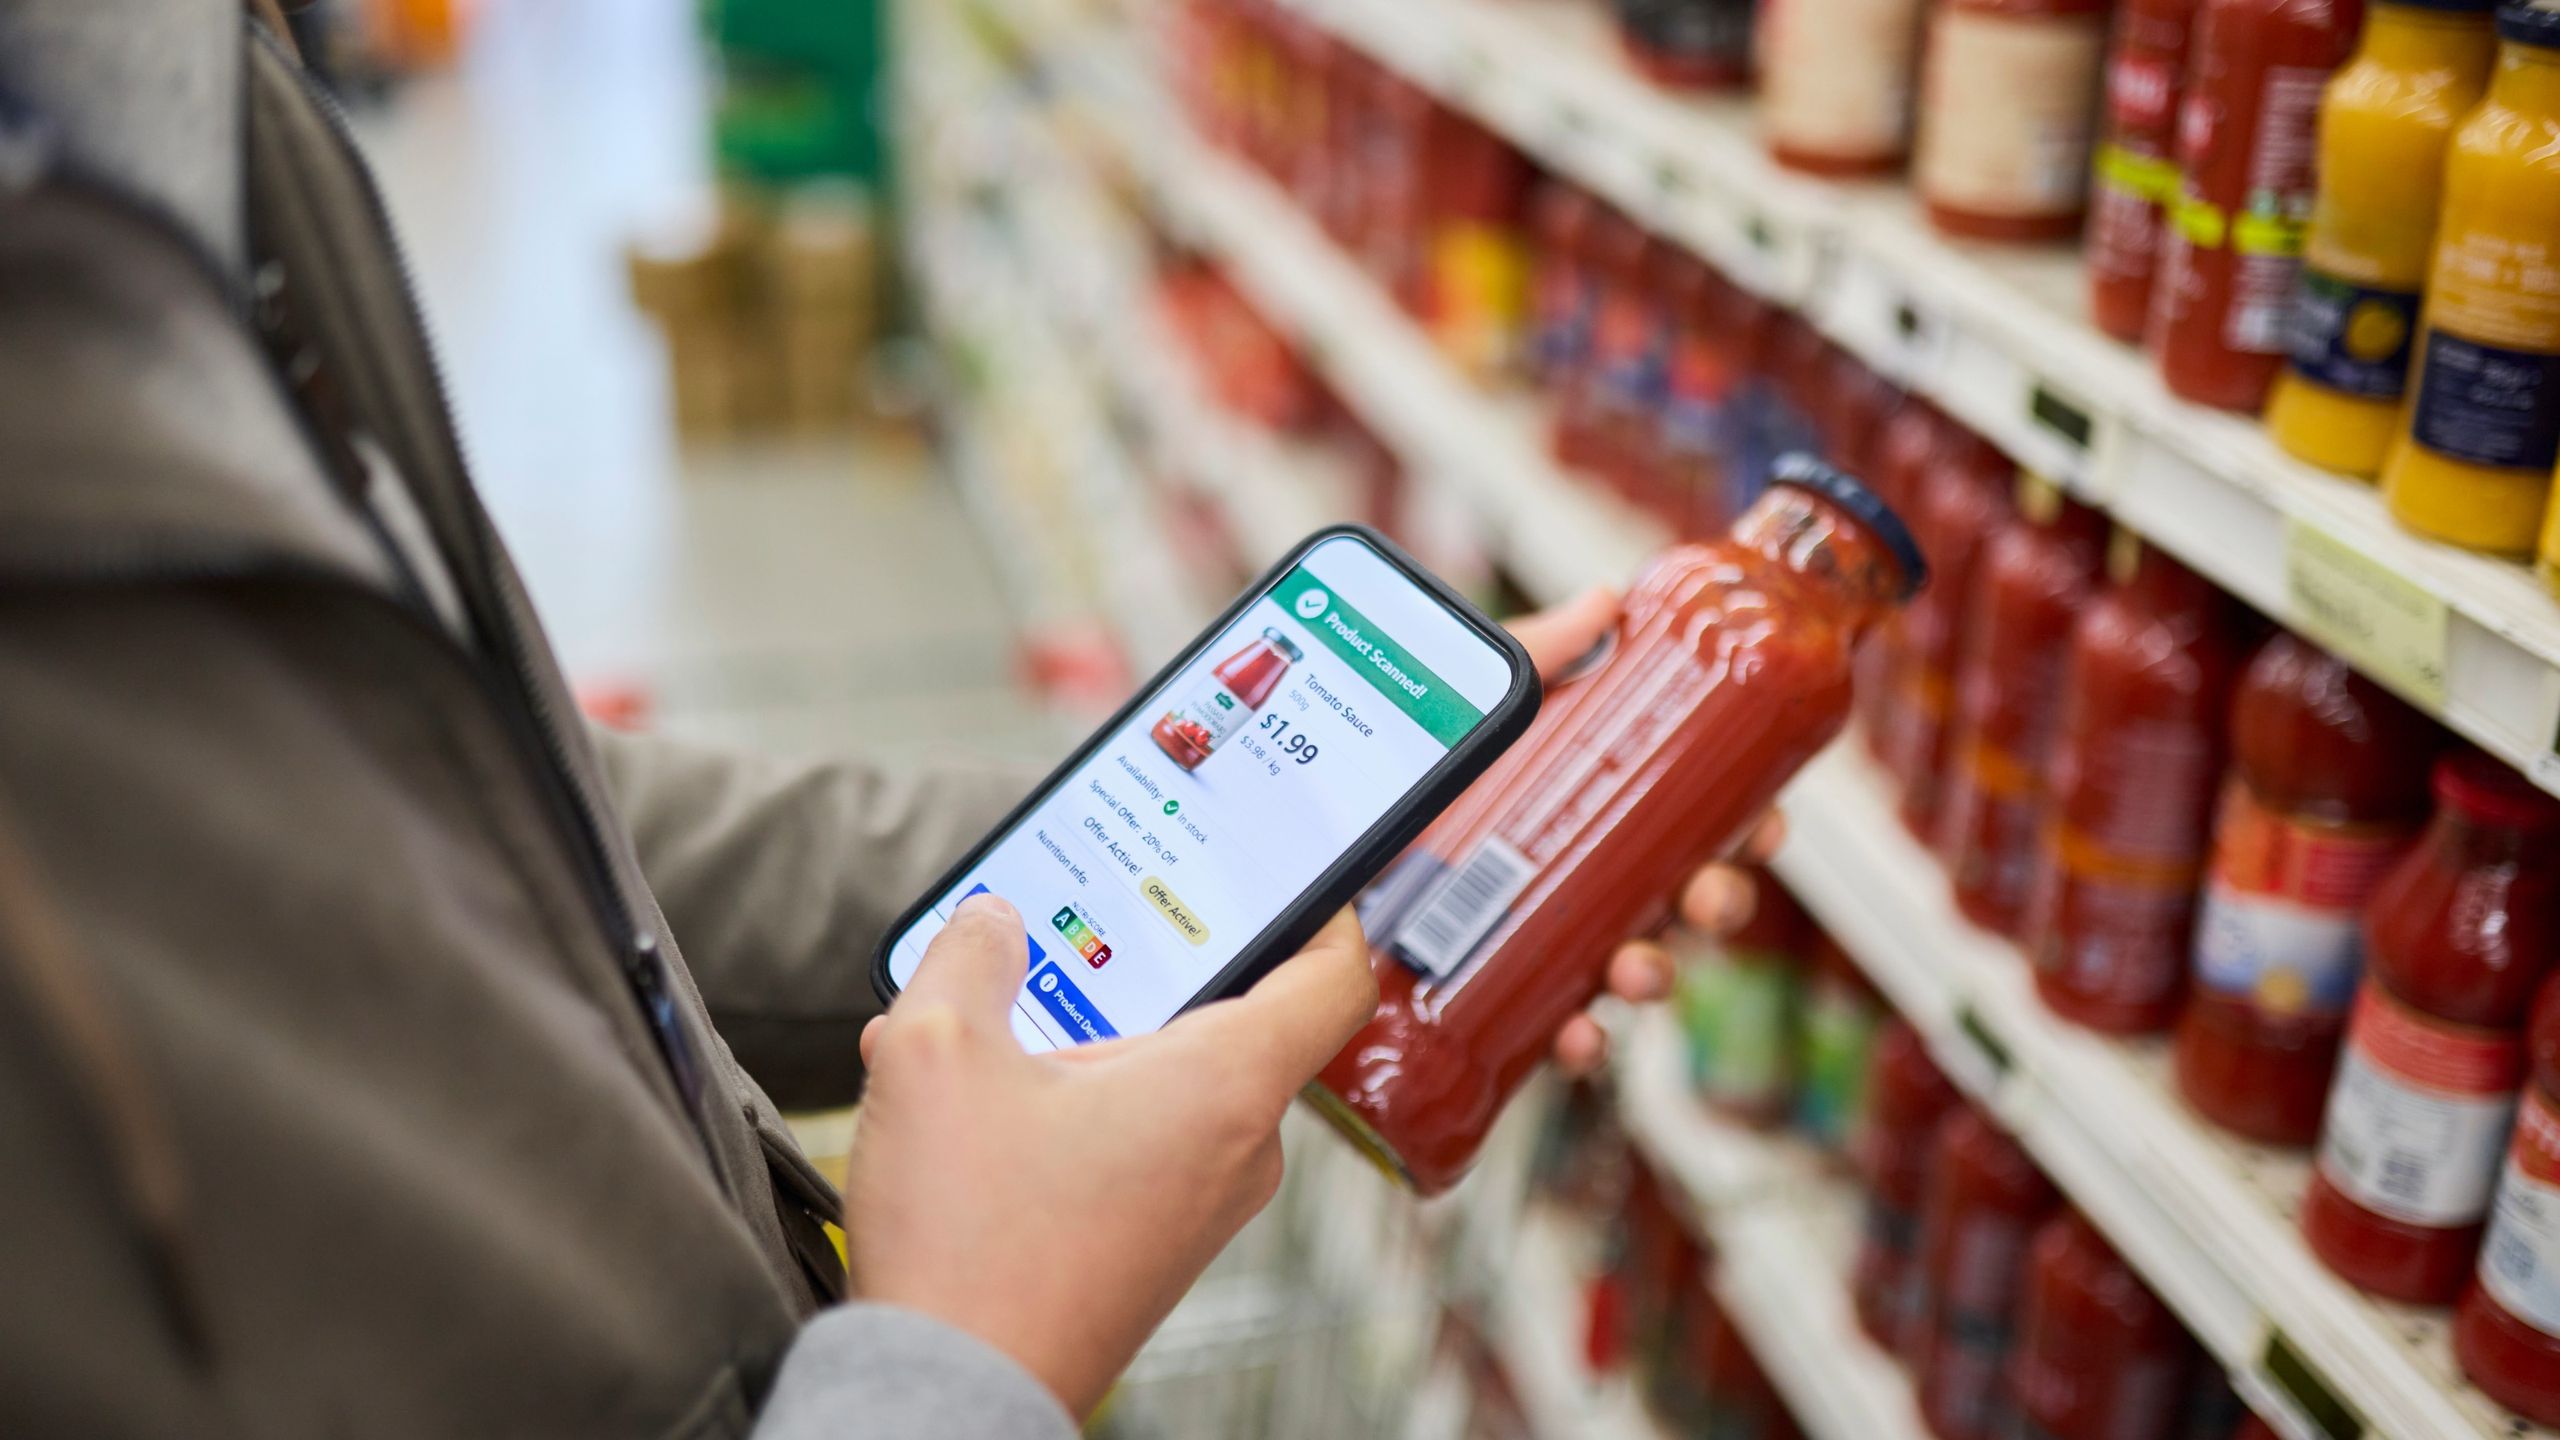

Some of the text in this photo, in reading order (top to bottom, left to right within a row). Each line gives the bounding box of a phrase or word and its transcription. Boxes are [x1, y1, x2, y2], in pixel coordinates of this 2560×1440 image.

[1324, 611, 1429, 700] Product Scanned!
[1288, 689, 1310, 712] 500g
[1304, 673, 1373, 738] Tomato Sauce
[1240, 735, 1267, 760] $3.98
[1268, 760, 1281, 776] kg
[1260, 713, 1319, 765] $1.99
[1089, 779, 1179, 867] Special Offer: 20% Off
[1116, 755, 1165, 802] Availability:
[1184, 822, 1209, 845] stock
[1036, 829, 1089, 887] Nutrition Info:
[1083, 816, 1143, 877] Offer Active!
[1055, 912, 1071, 927] A
[1068, 924, 1080, 936] B
[1084, 941, 1097, 953] D
[1093, 951, 1107, 965] E
[1148, 885, 1202, 937] Offer Active!
[1053, 989, 1084, 1024] Product
